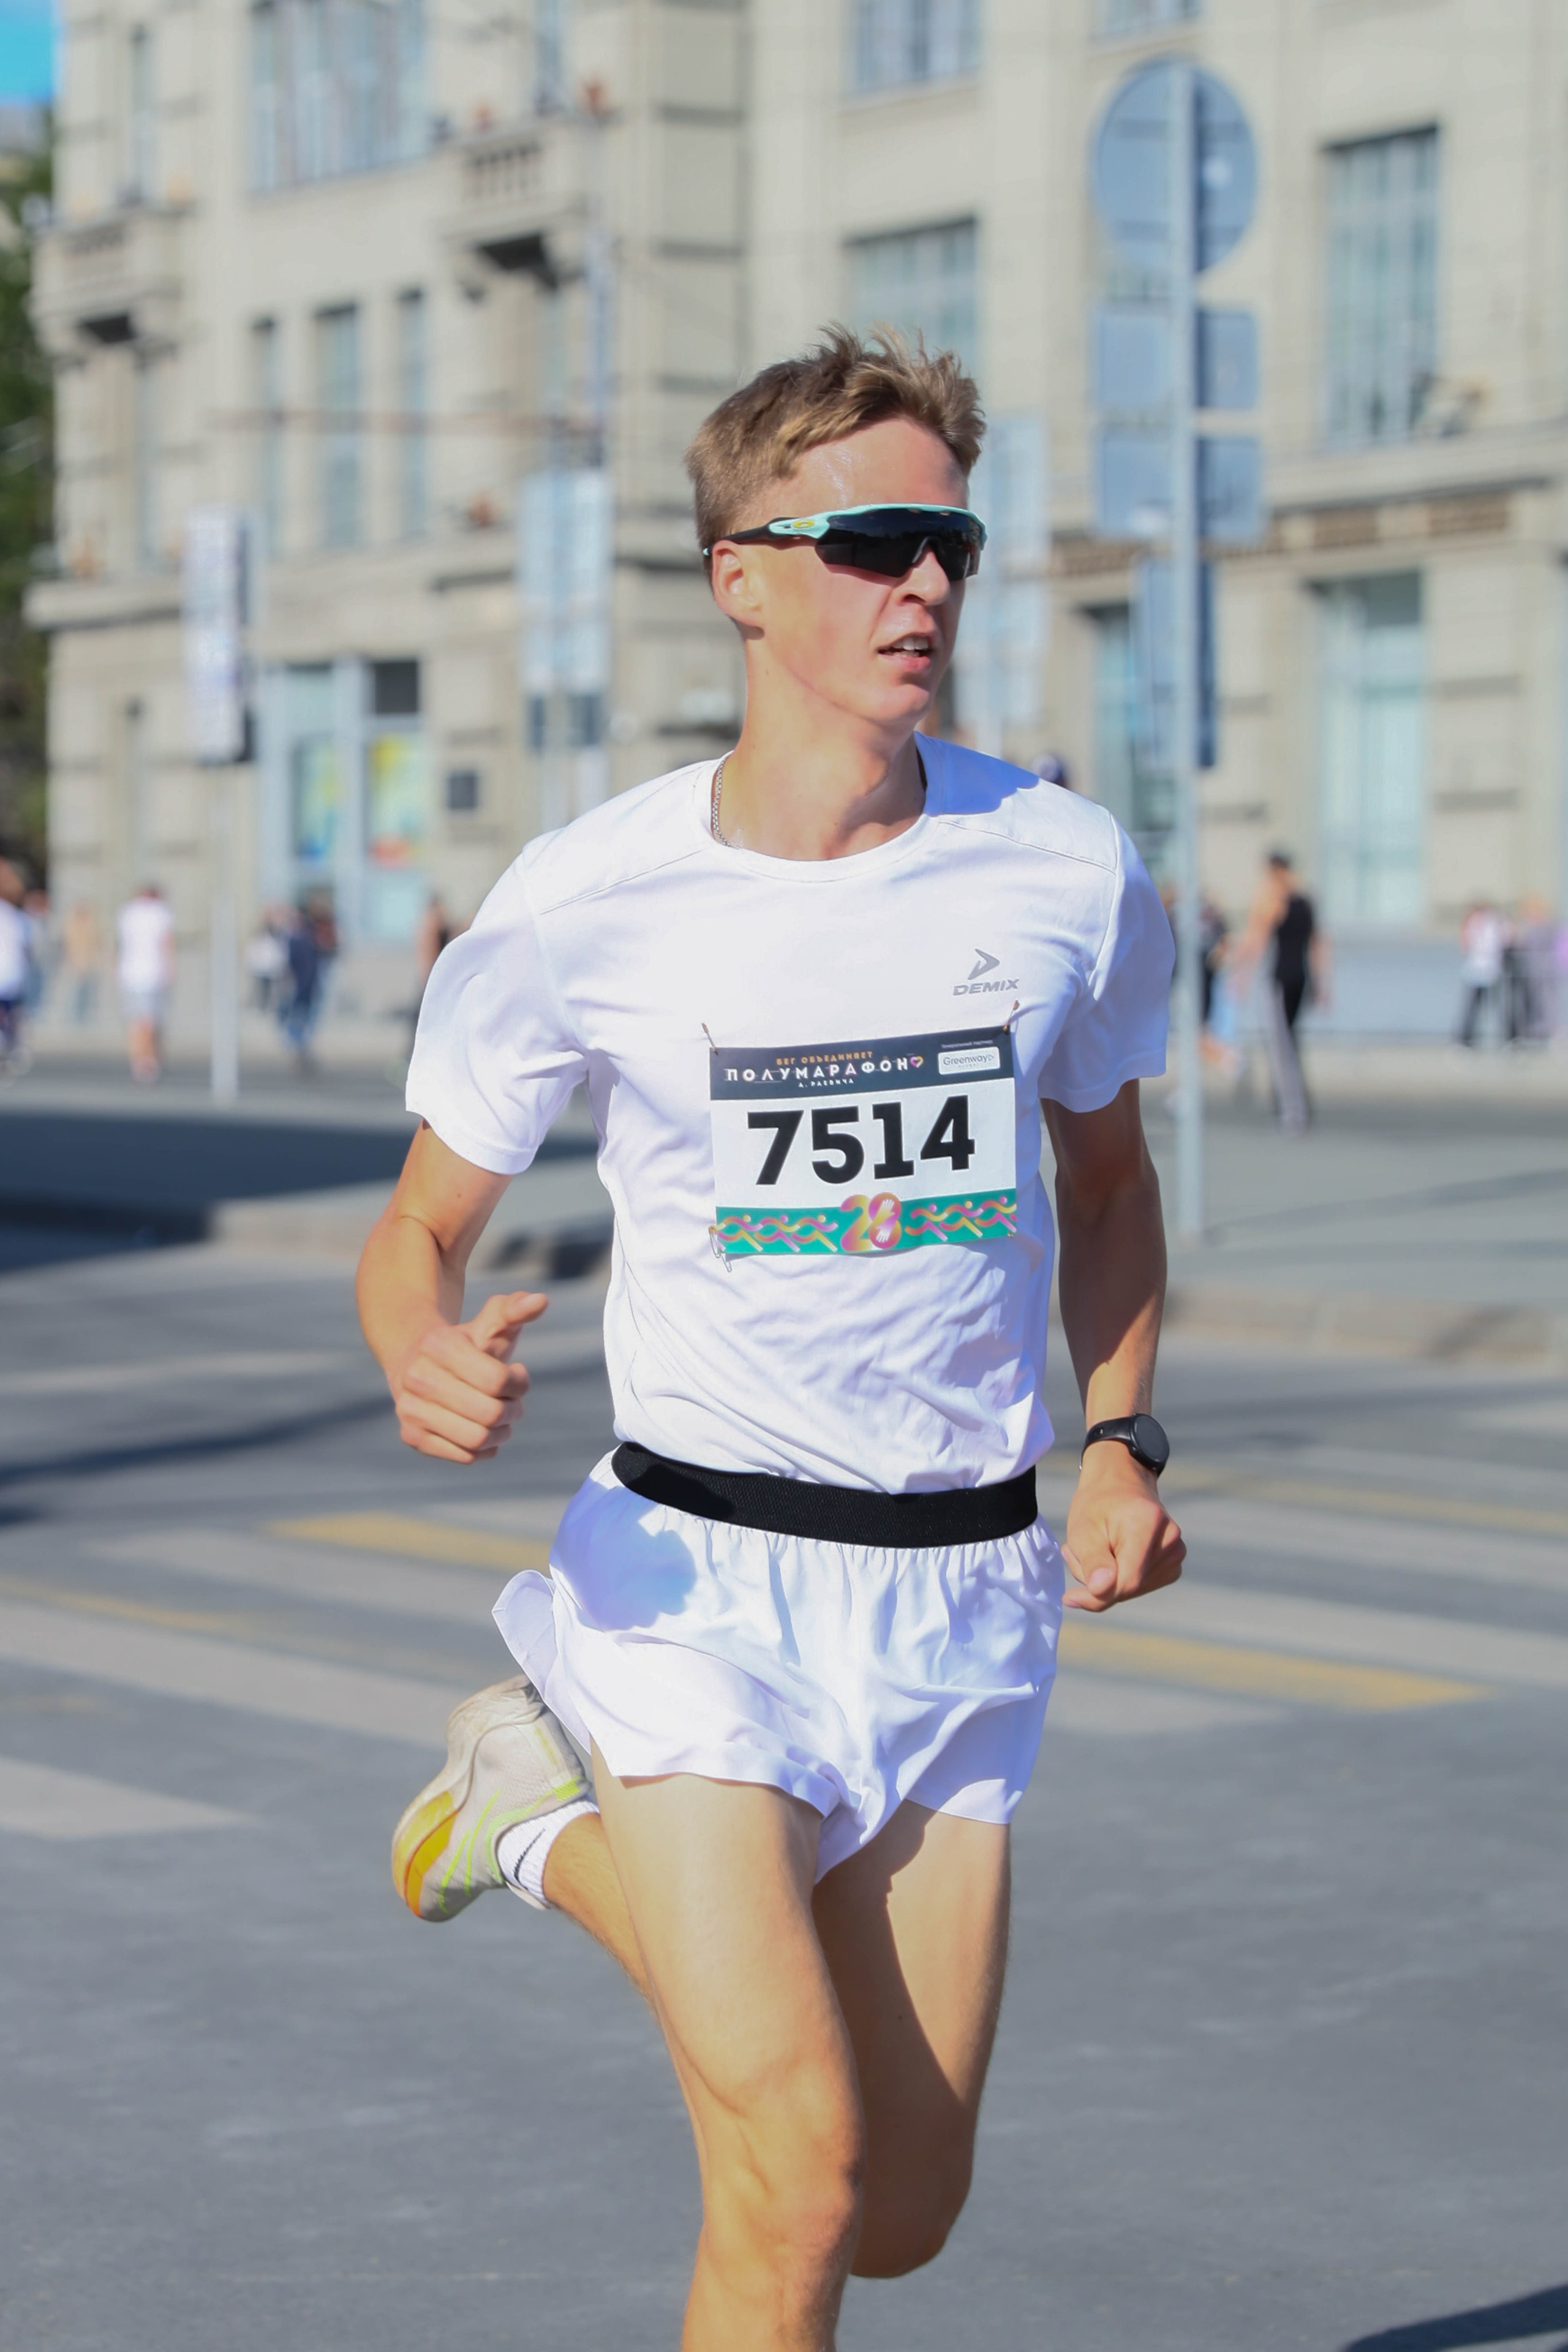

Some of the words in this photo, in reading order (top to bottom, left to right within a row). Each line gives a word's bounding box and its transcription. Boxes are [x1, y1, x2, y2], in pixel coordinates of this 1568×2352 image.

[953, 979, 1019, 995] DEMIX
[801, 1051, 873, 1064] ОБЪЕДИНЯЕТ
[943, 1055, 987, 1065] Greenway
[726, 1057, 908, 1082] ПОЛУМАРАФОН
[747, 1095, 975, 1185] 7514
[840, 1192, 902, 1251] 28
